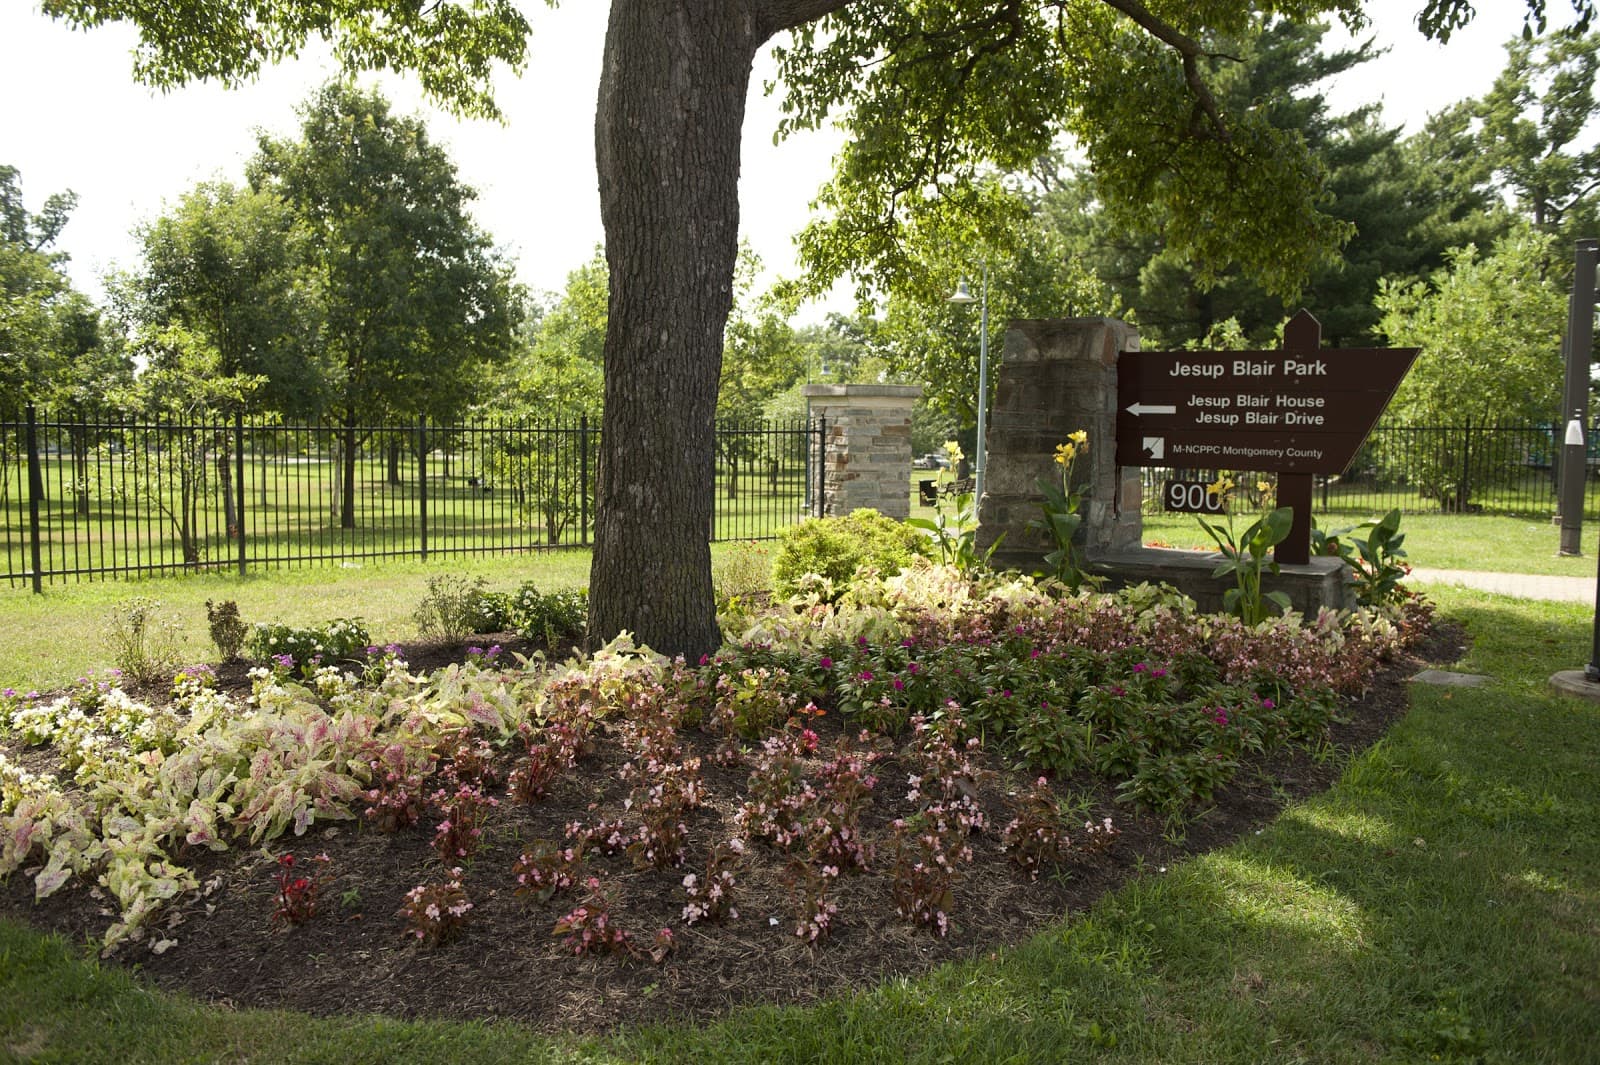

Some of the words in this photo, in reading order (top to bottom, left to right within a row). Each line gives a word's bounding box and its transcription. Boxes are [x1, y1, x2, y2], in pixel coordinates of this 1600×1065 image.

[1169, 361, 1225, 379] Jesup
[1232, 360, 1276, 376] Blair
[1283, 360, 1327, 376] Park
[1187, 395, 1231, 408] Jesup
[1236, 395, 1270, 407] Blair
[1276, 395, 1325, 408] House
[1195, 411, 1239, 425] Jesup
[1245, 412, 1278, 424] Blair
[1285, 412, 1325, 425] Drive
[1172, 444, 1220, 455] M-NCPPC
[1222, 446, 1284, 457] Montgomery
[1286, 448, 1323, 459] County
